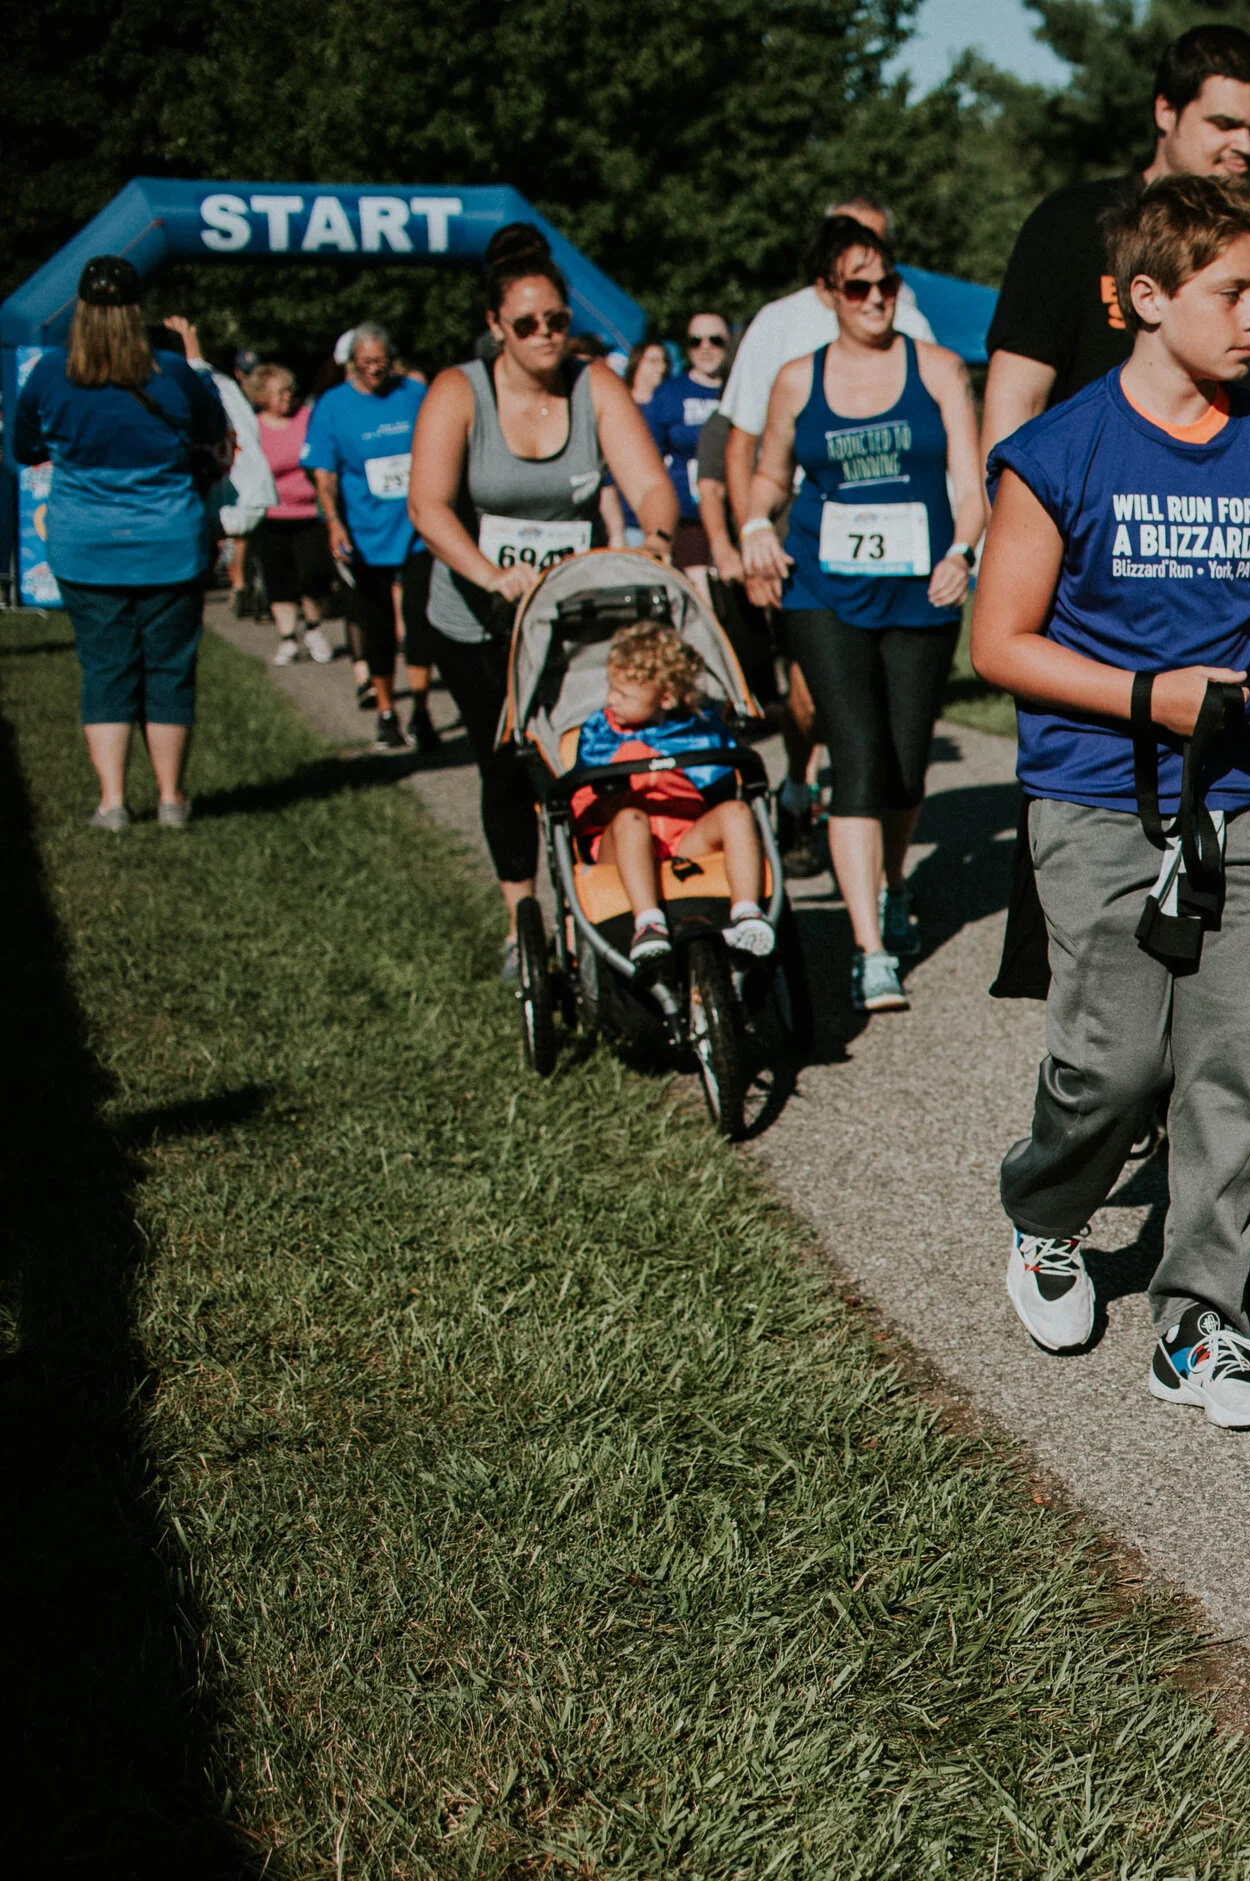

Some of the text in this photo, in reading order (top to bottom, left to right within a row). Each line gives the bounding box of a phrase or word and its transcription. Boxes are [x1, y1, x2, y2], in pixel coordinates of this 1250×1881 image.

[200, 194, 463, 252] START
[893, 424, 912, 451] TO
[1112, 494, 1164, 521] WILL
[1166, 495, 1213, 523] RUN
[848, 533, 885, 559] 73
[1112, 524, 1133, 556] A
[1169, 558, 1193, 578] Run
[1208, 560, 1233, 580] York,
[1235, 561, 1250, 578] PA
